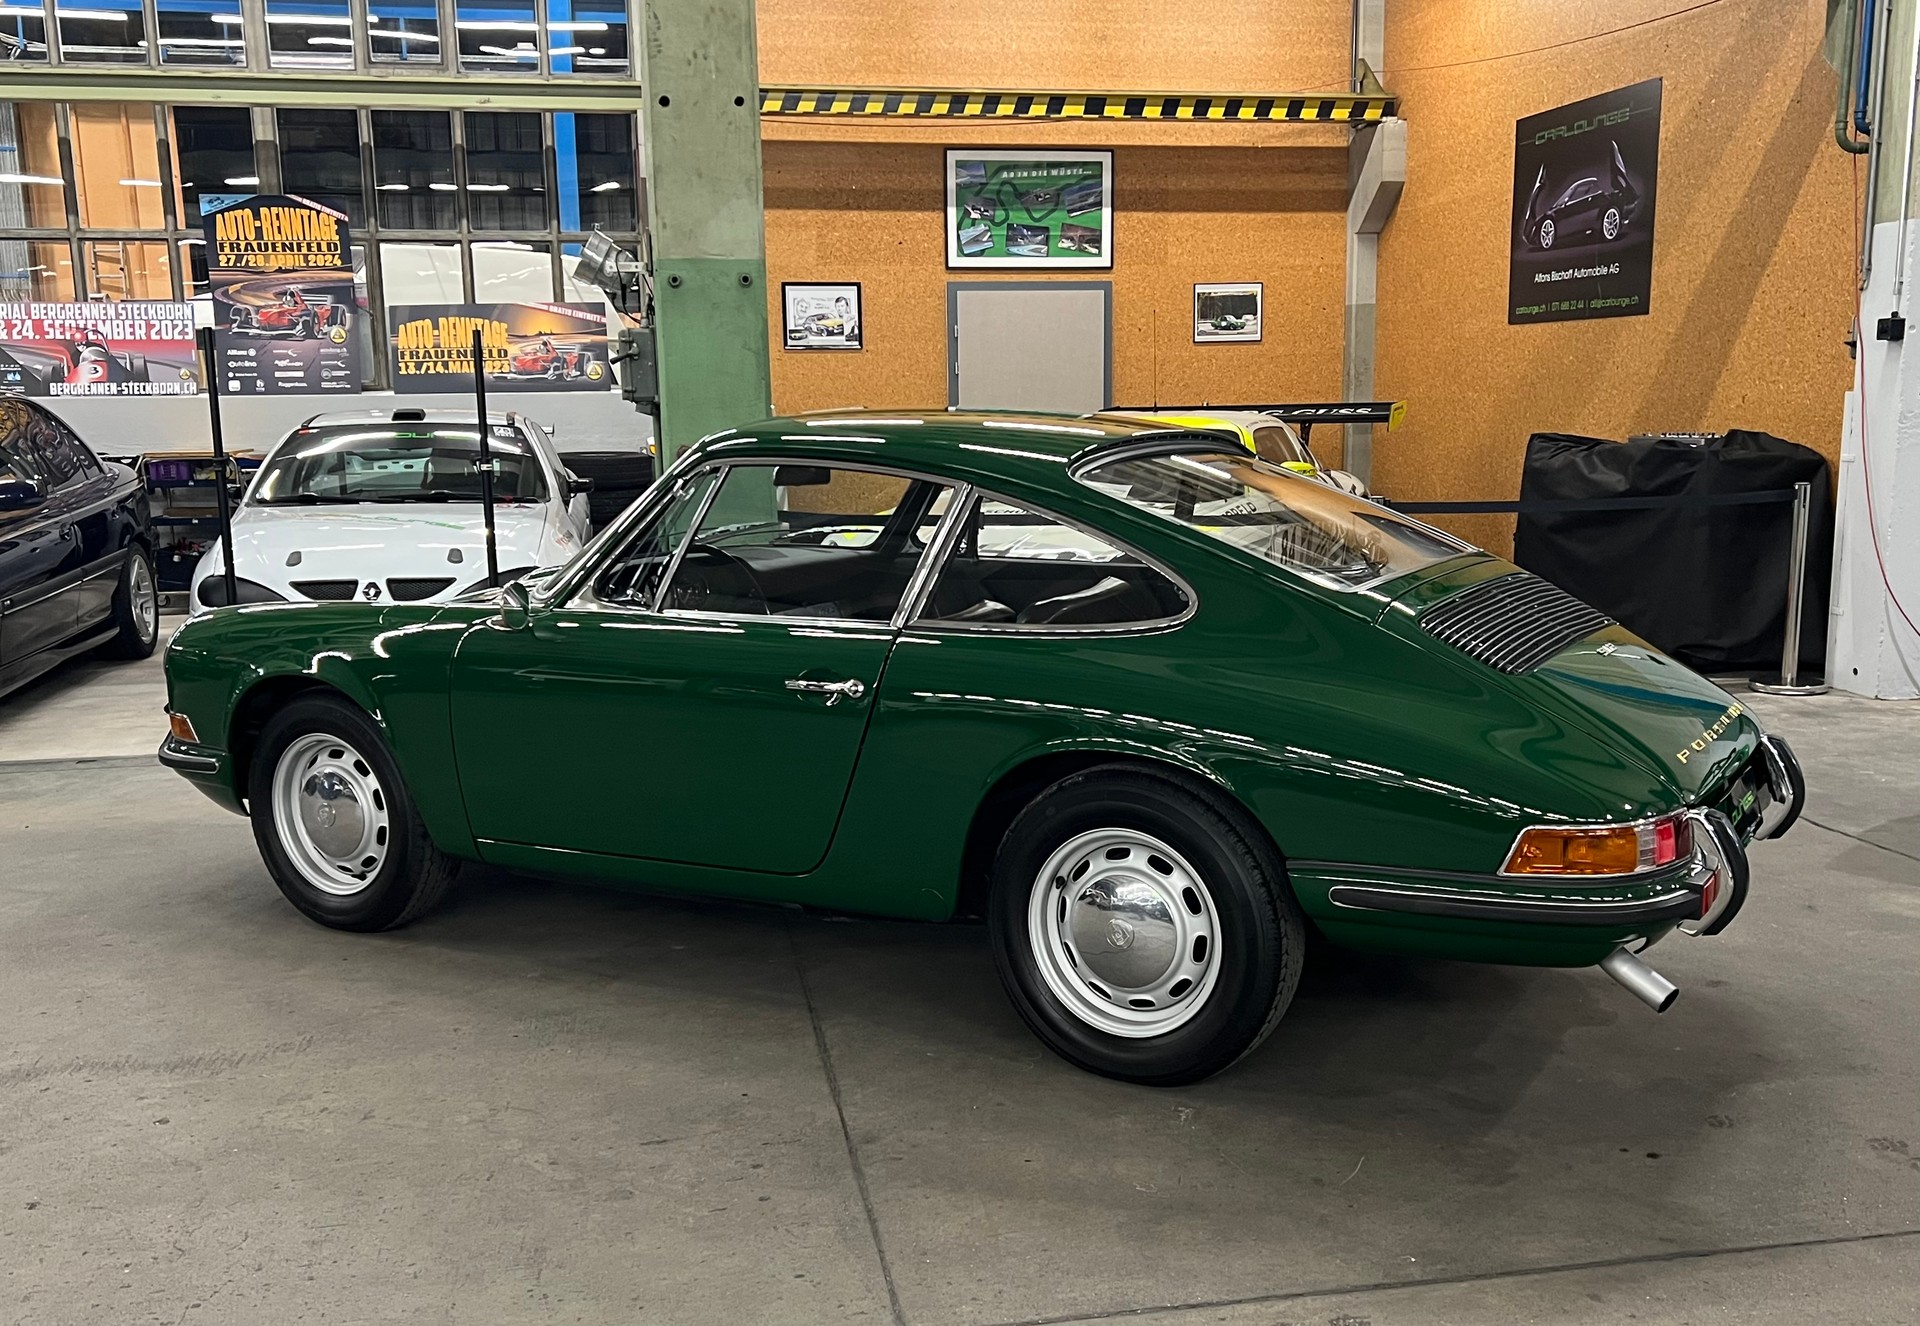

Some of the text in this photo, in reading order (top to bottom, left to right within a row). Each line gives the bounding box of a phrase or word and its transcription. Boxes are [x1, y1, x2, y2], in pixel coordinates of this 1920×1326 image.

[1535, 107, 1630, 145] CARLOUNGE
[215, 207, 339, 241] AUTO-RENNTAGE
[217, 241, 339, 253] FRAUENFELD
[308, 254, 342, 267] 2024
[1551, 268, 1573, 281] Bischoff
[1573, 265, 1608, 279] Automobile
[1608, 262, 1620, 274] AG
[30, 303, 116, 320] BERGRENNEN
[119, 303, 193, 320] STECKBORN
[11, 320, 41, 340] 24.
[43, 320, 147, 340] SEPTEMBER
[150, 320, 194, 340] 2023
[49, 382, 197, 395] BERGRENNEN-STECKBORN.CH
